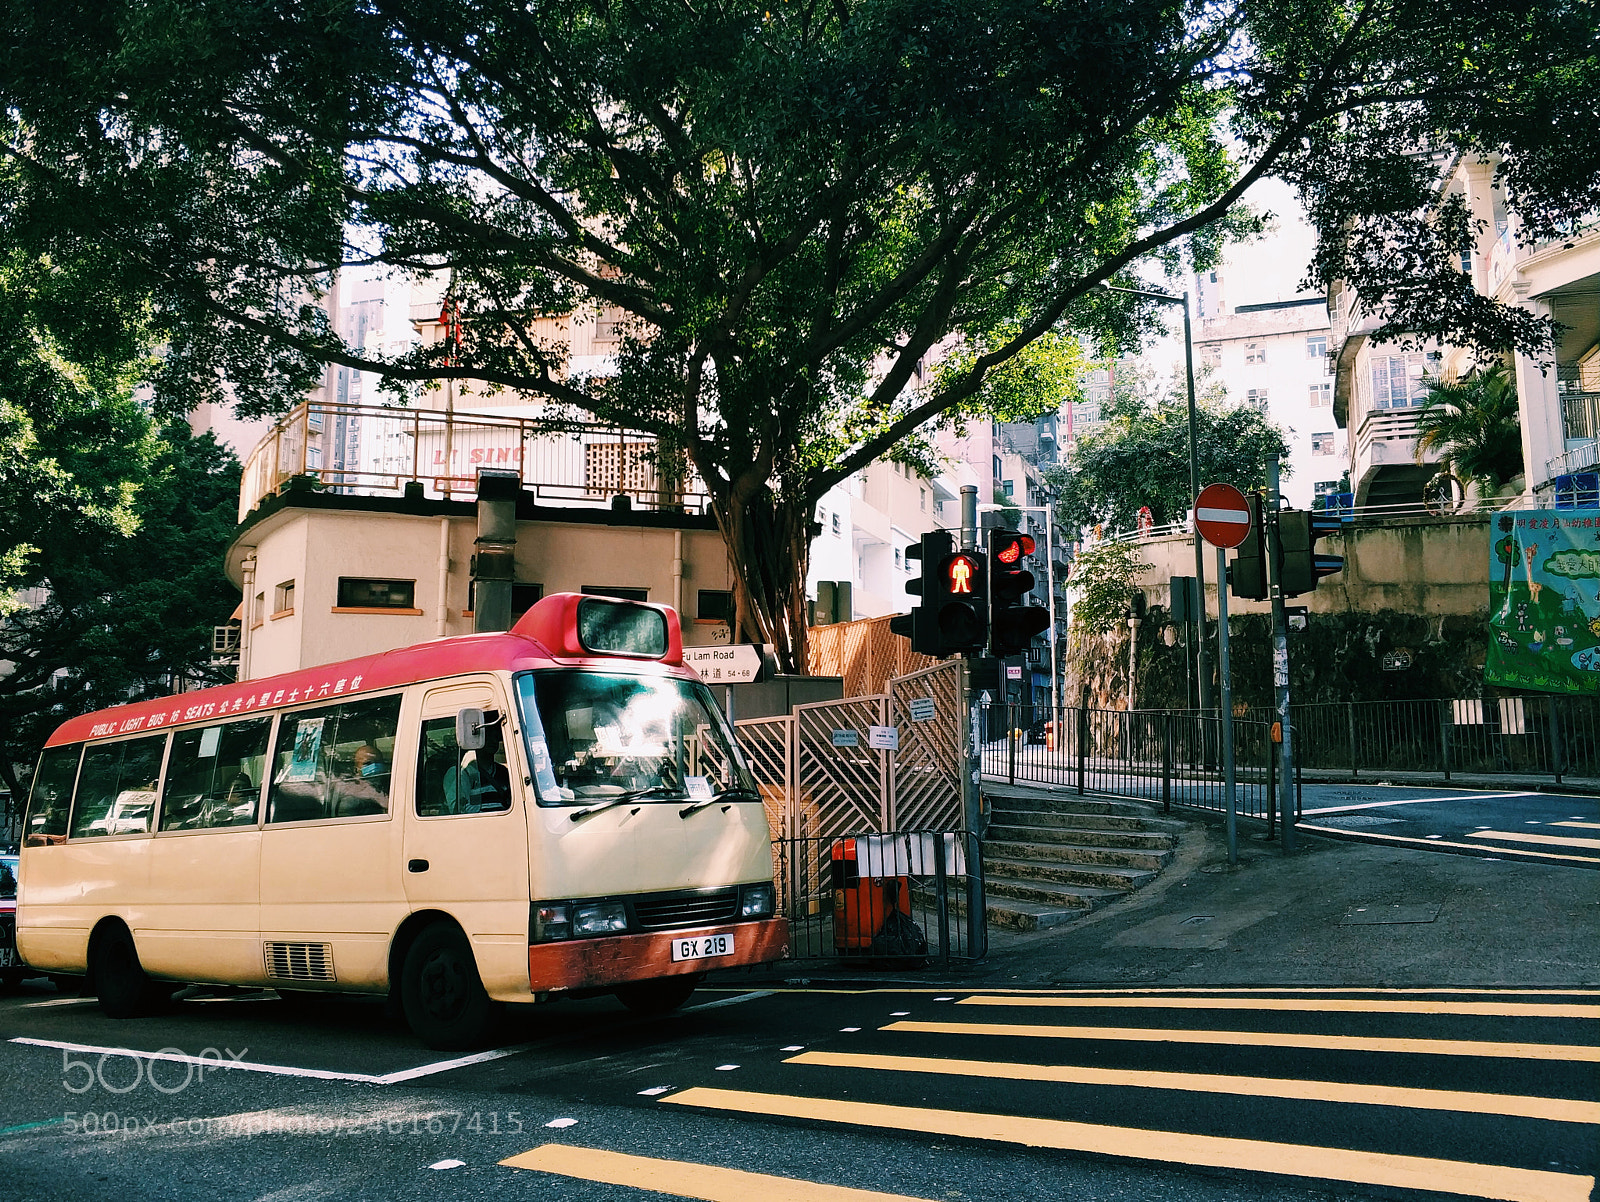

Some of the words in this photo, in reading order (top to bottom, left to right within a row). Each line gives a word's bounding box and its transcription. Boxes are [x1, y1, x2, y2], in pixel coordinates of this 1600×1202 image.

[693, 651, 711, 660] Lam
[713, 650, 735, 660] Road
[218, 675, 362, 713] 公共小型巴士十六座位
[89, 721, 118, 738] PUBLIC
[119, 716, 146, 732] LIGHT
[147, 712, 167, 727] BUS
[170, 709, 181, 723] 16
[184, 702, 216, 720] SEATS
[681, 940, 698, 957] GX
[704, 937, 726, 955] 219
